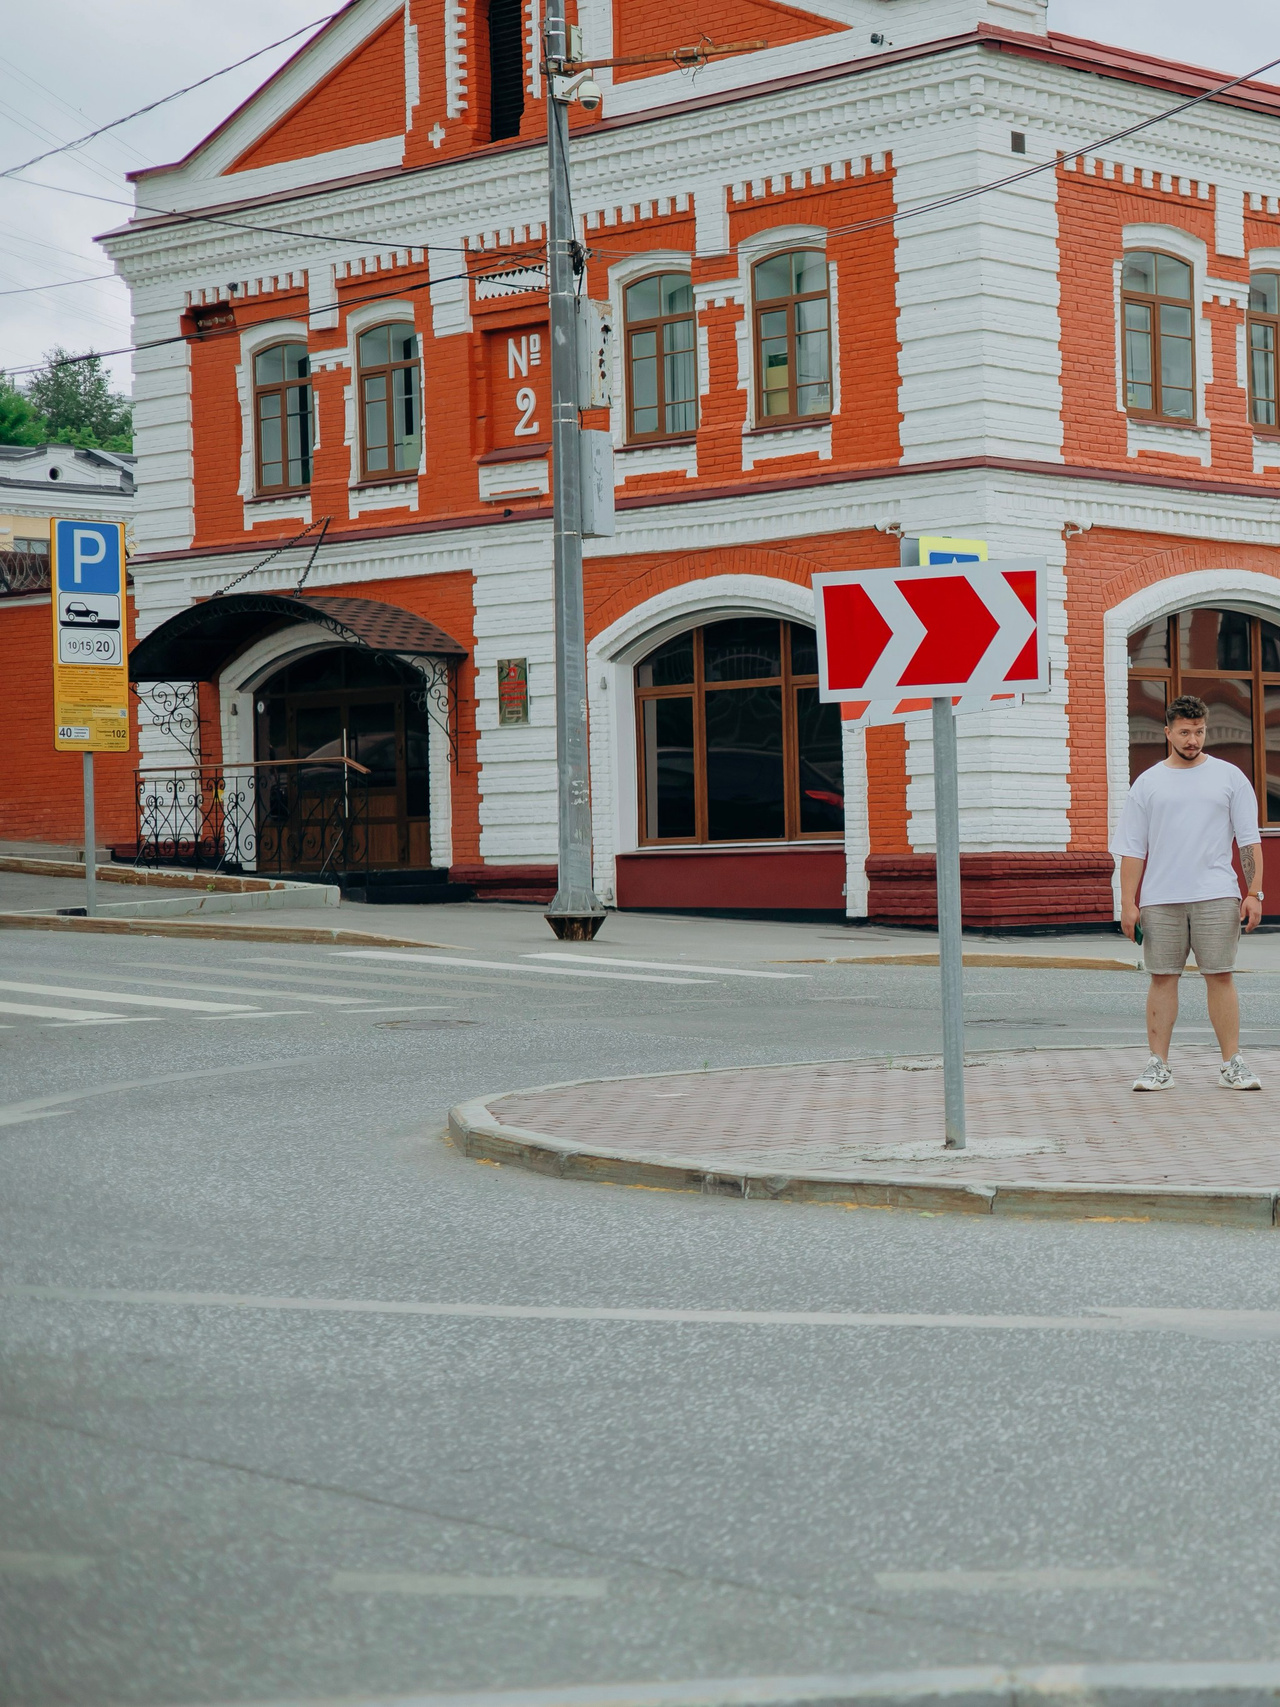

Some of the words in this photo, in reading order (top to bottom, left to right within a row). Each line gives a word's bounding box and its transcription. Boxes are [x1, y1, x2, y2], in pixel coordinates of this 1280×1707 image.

[514, 387, 539, 436] 2
[73, 529, 106, 583] P
[68, 641, 77, 650] 10
[80, 641, 92, 651] 15
[96, 640, 110, 653] 20
[59, 727, 72, 738] 40
[112, 729, 127, 739] 102
